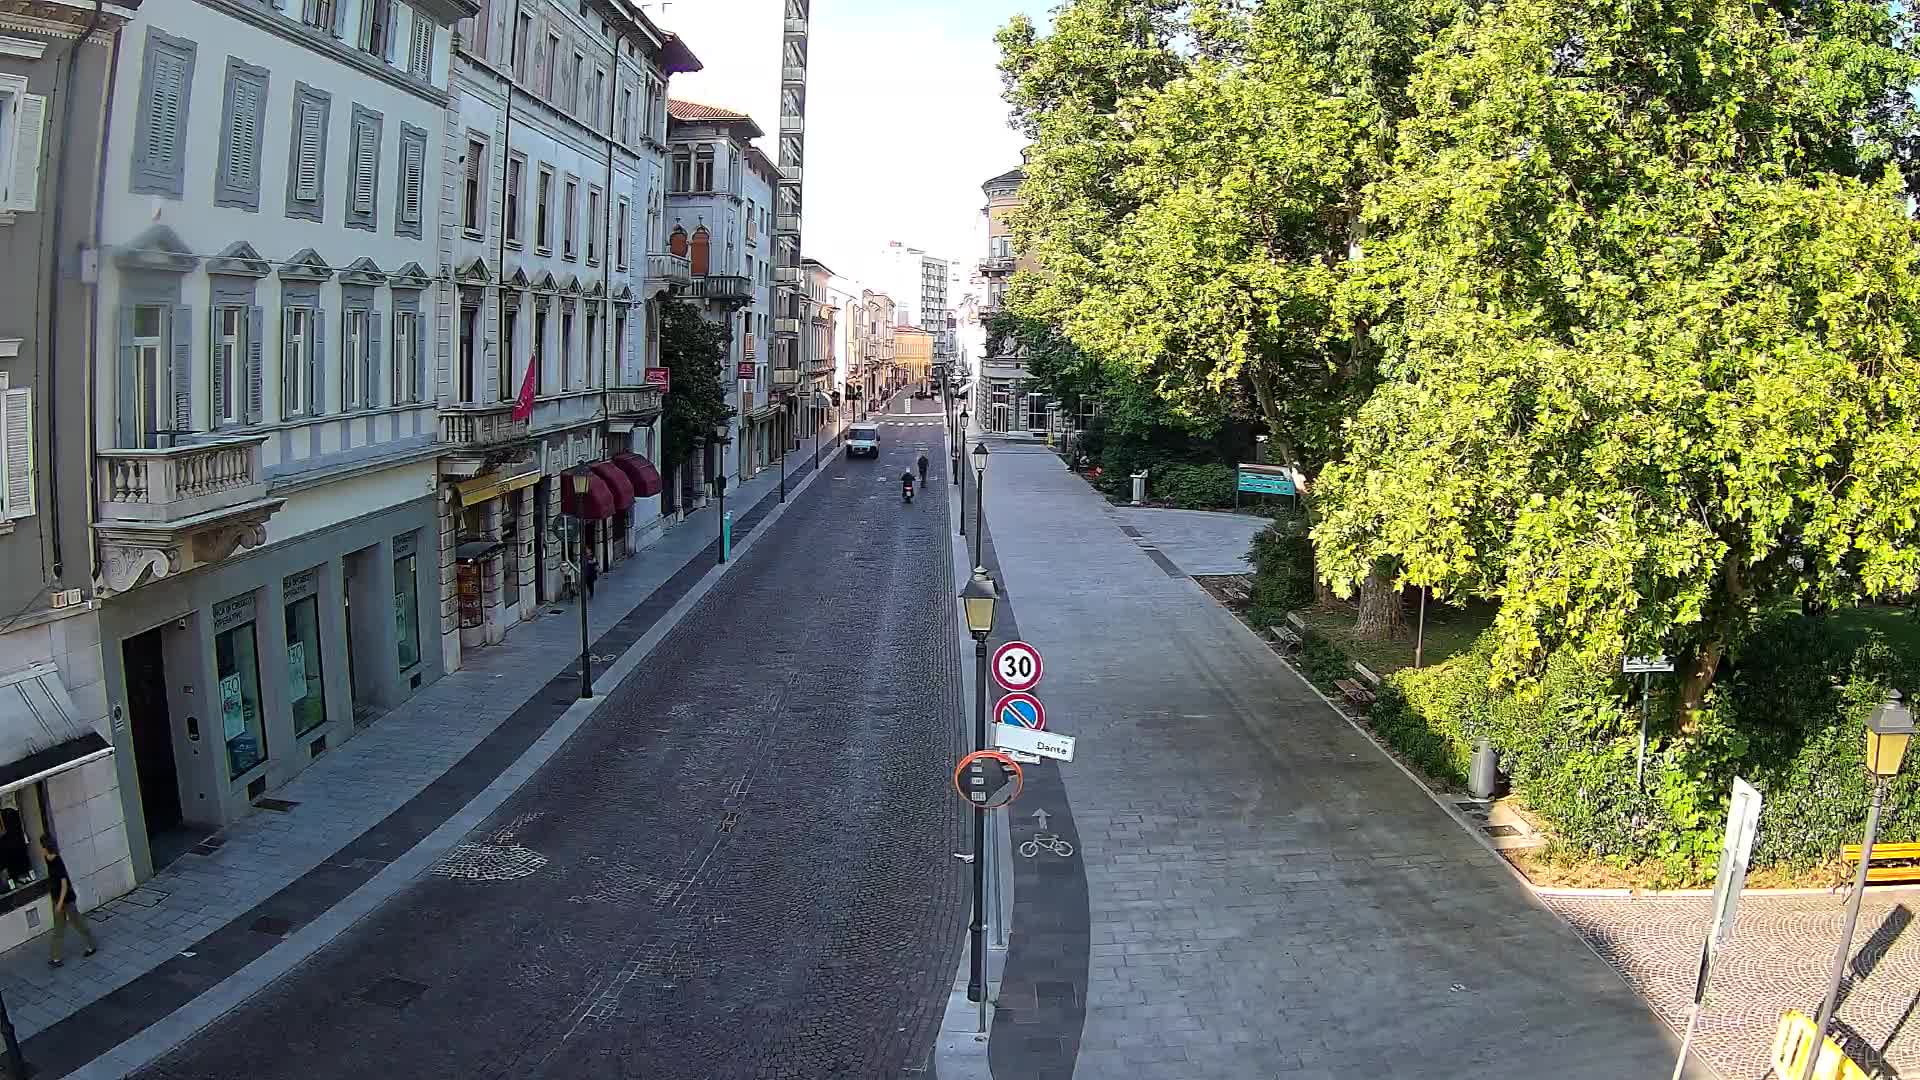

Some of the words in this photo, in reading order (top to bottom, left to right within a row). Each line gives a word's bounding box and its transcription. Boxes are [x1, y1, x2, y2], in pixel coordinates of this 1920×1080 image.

[1004, 655, 1031, 677] 30
[223, 677, 240, 700] 130
[1037, 741, 1067, 755] Dante
